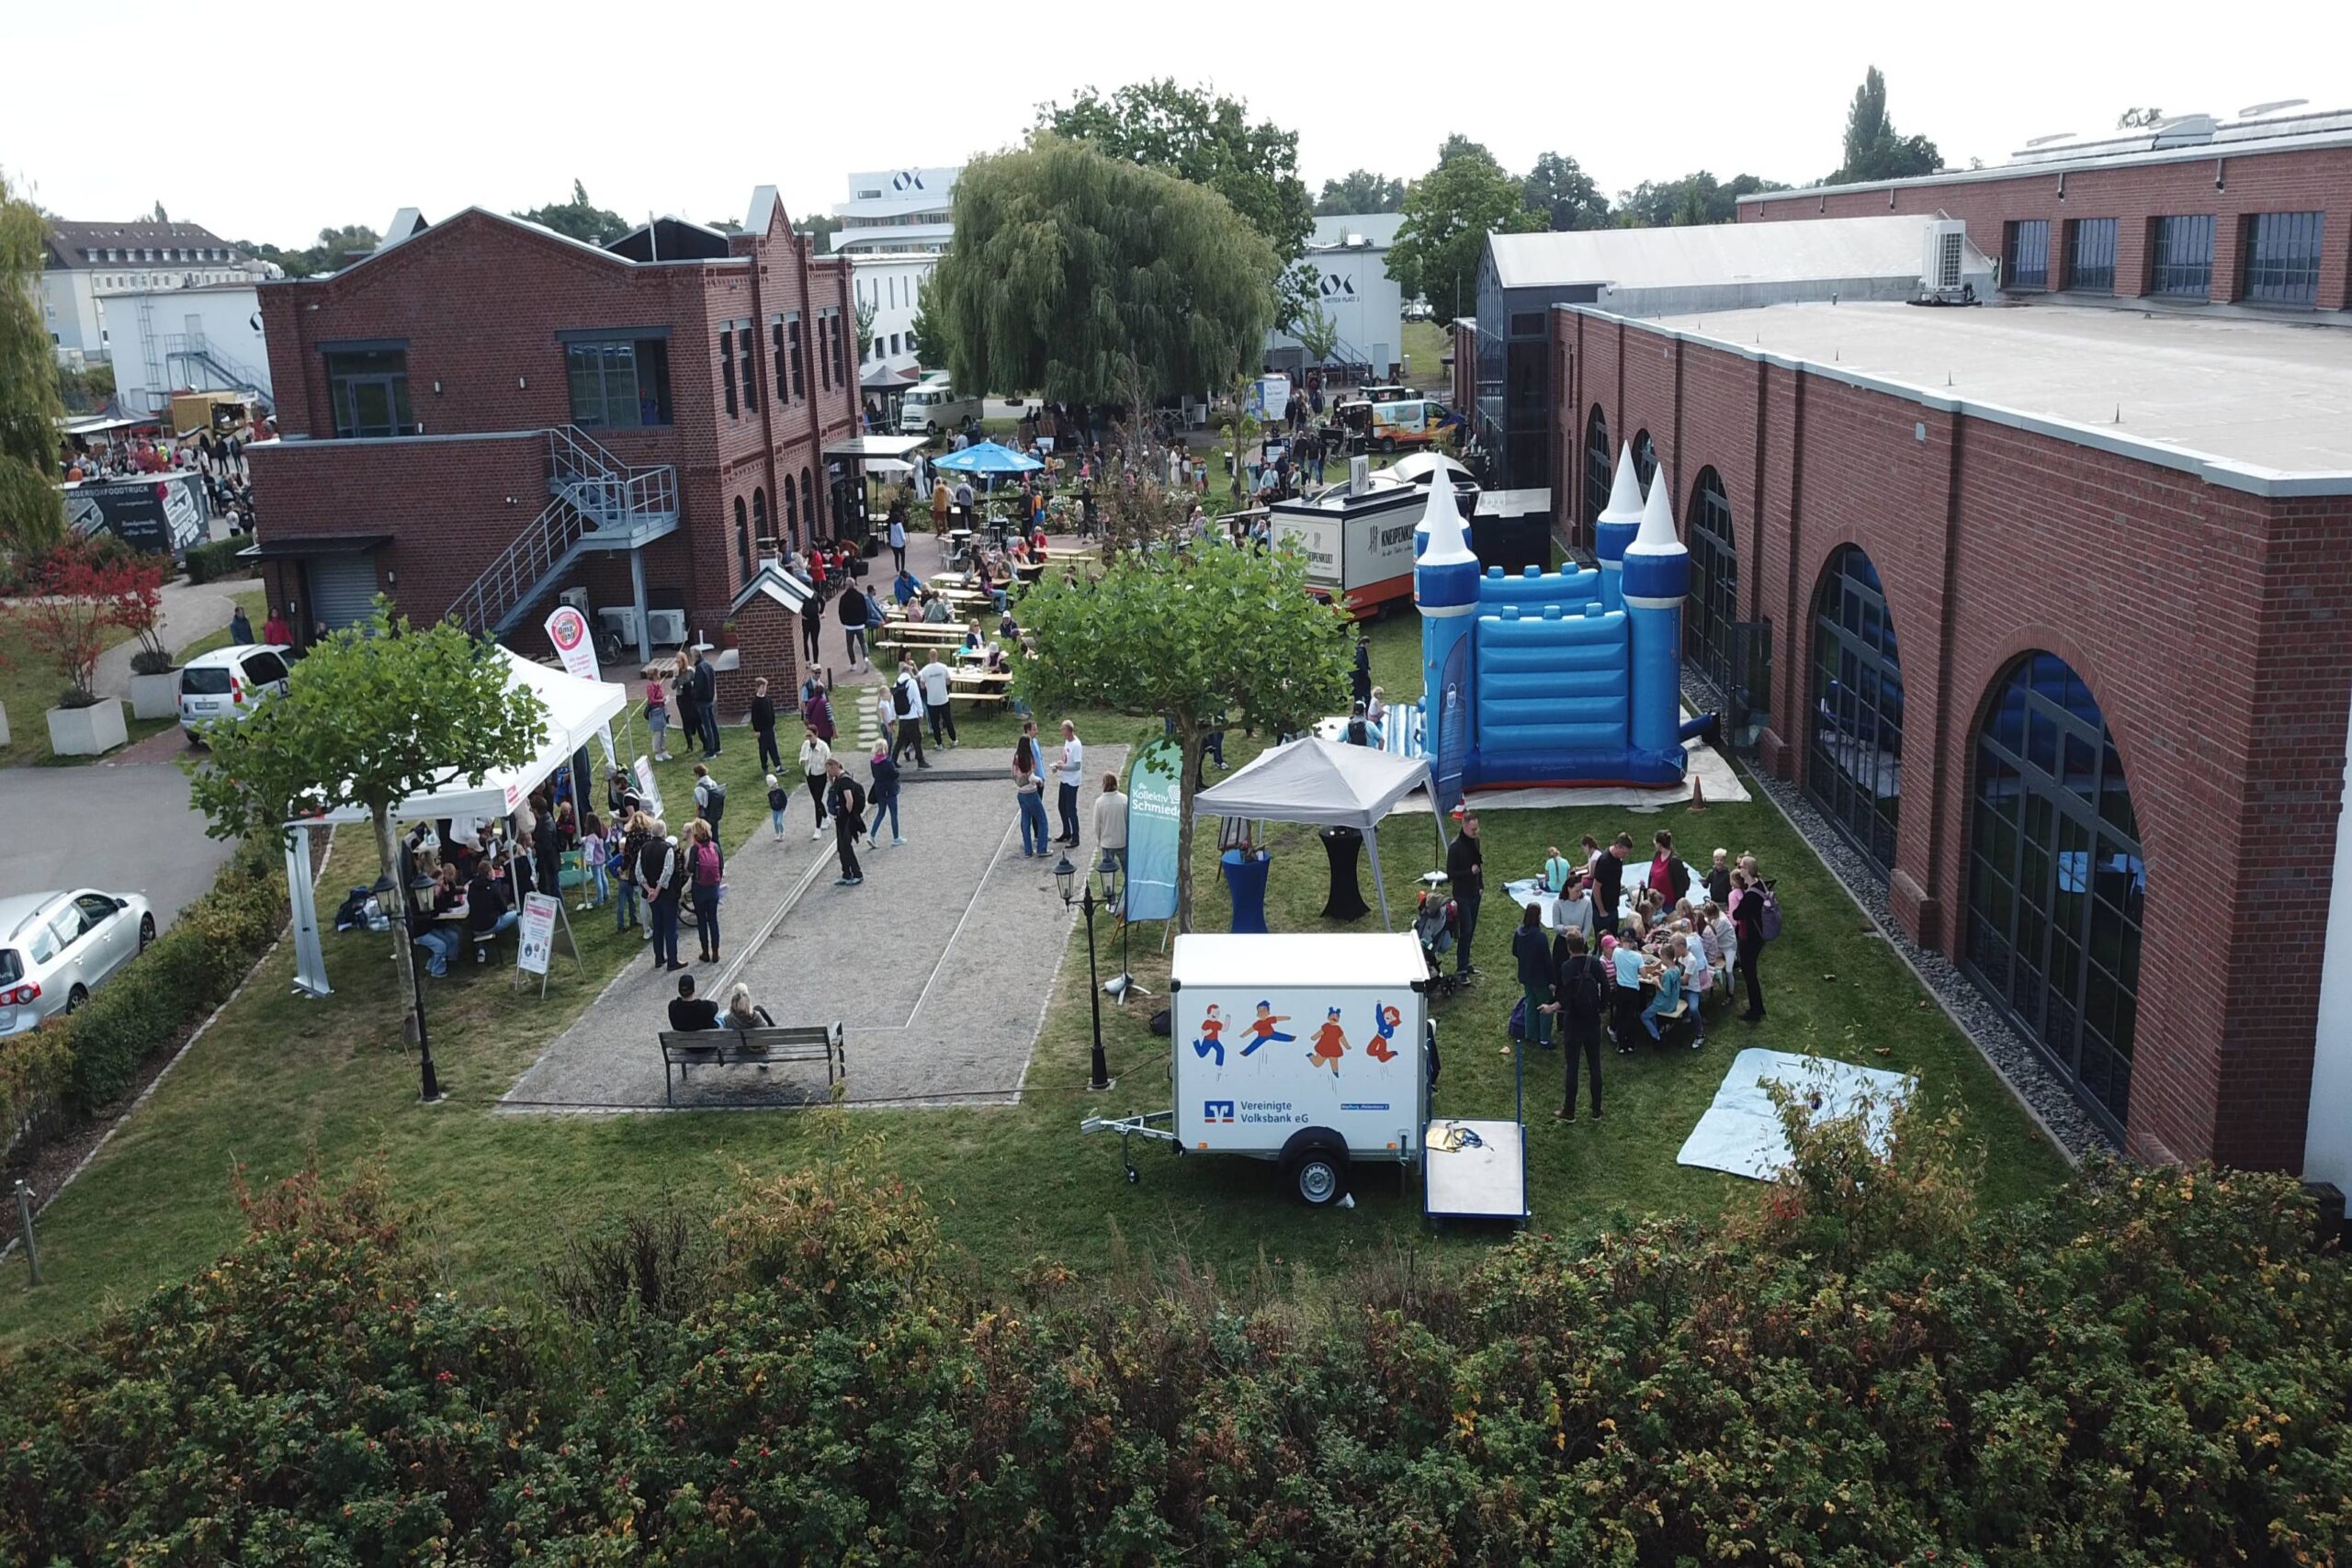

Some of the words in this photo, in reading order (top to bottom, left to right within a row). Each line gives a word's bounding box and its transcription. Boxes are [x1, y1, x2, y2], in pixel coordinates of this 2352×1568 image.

[64, 485, 150, 498] URGERBOXFOODTRUCK
[1132, 789, 1169, 803] Kollektiv
[1240, 1100, 1292, 1112] Vereinigte
[1240, 1113, 1292, 1123] Volksbank
[1295, 1113, 1309, 1123] eG
